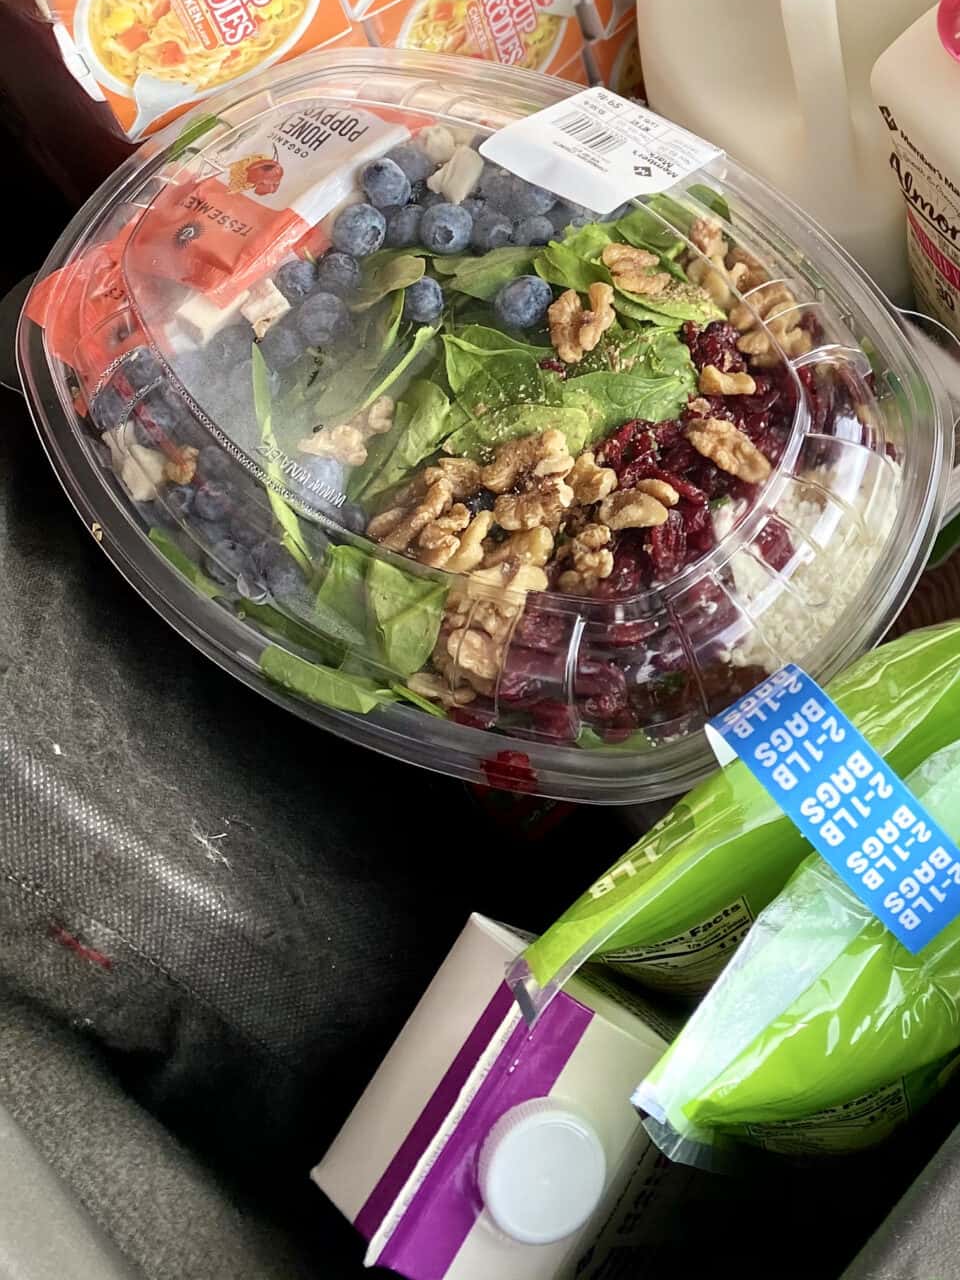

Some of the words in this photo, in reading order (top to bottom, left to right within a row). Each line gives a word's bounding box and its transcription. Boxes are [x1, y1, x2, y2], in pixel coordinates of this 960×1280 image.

[273, 118, 332, 151] HONEY
[632, 149, 679, 179] Member's
[900, 130, 943, 180] Member's
[754, 697, 826, 768] BAGS
[771, 717, 846, 791] 2-1LB
[800, 750, 874, 825] BAGS
[818, 772, 894, 847] 2-1LB
[846, 805, 917, 875] BAGS
[861, 821, 933, 891] 2-1LB
[883, 846, 954, 914] BAGS
[689, 903, 741, 938] Facts
